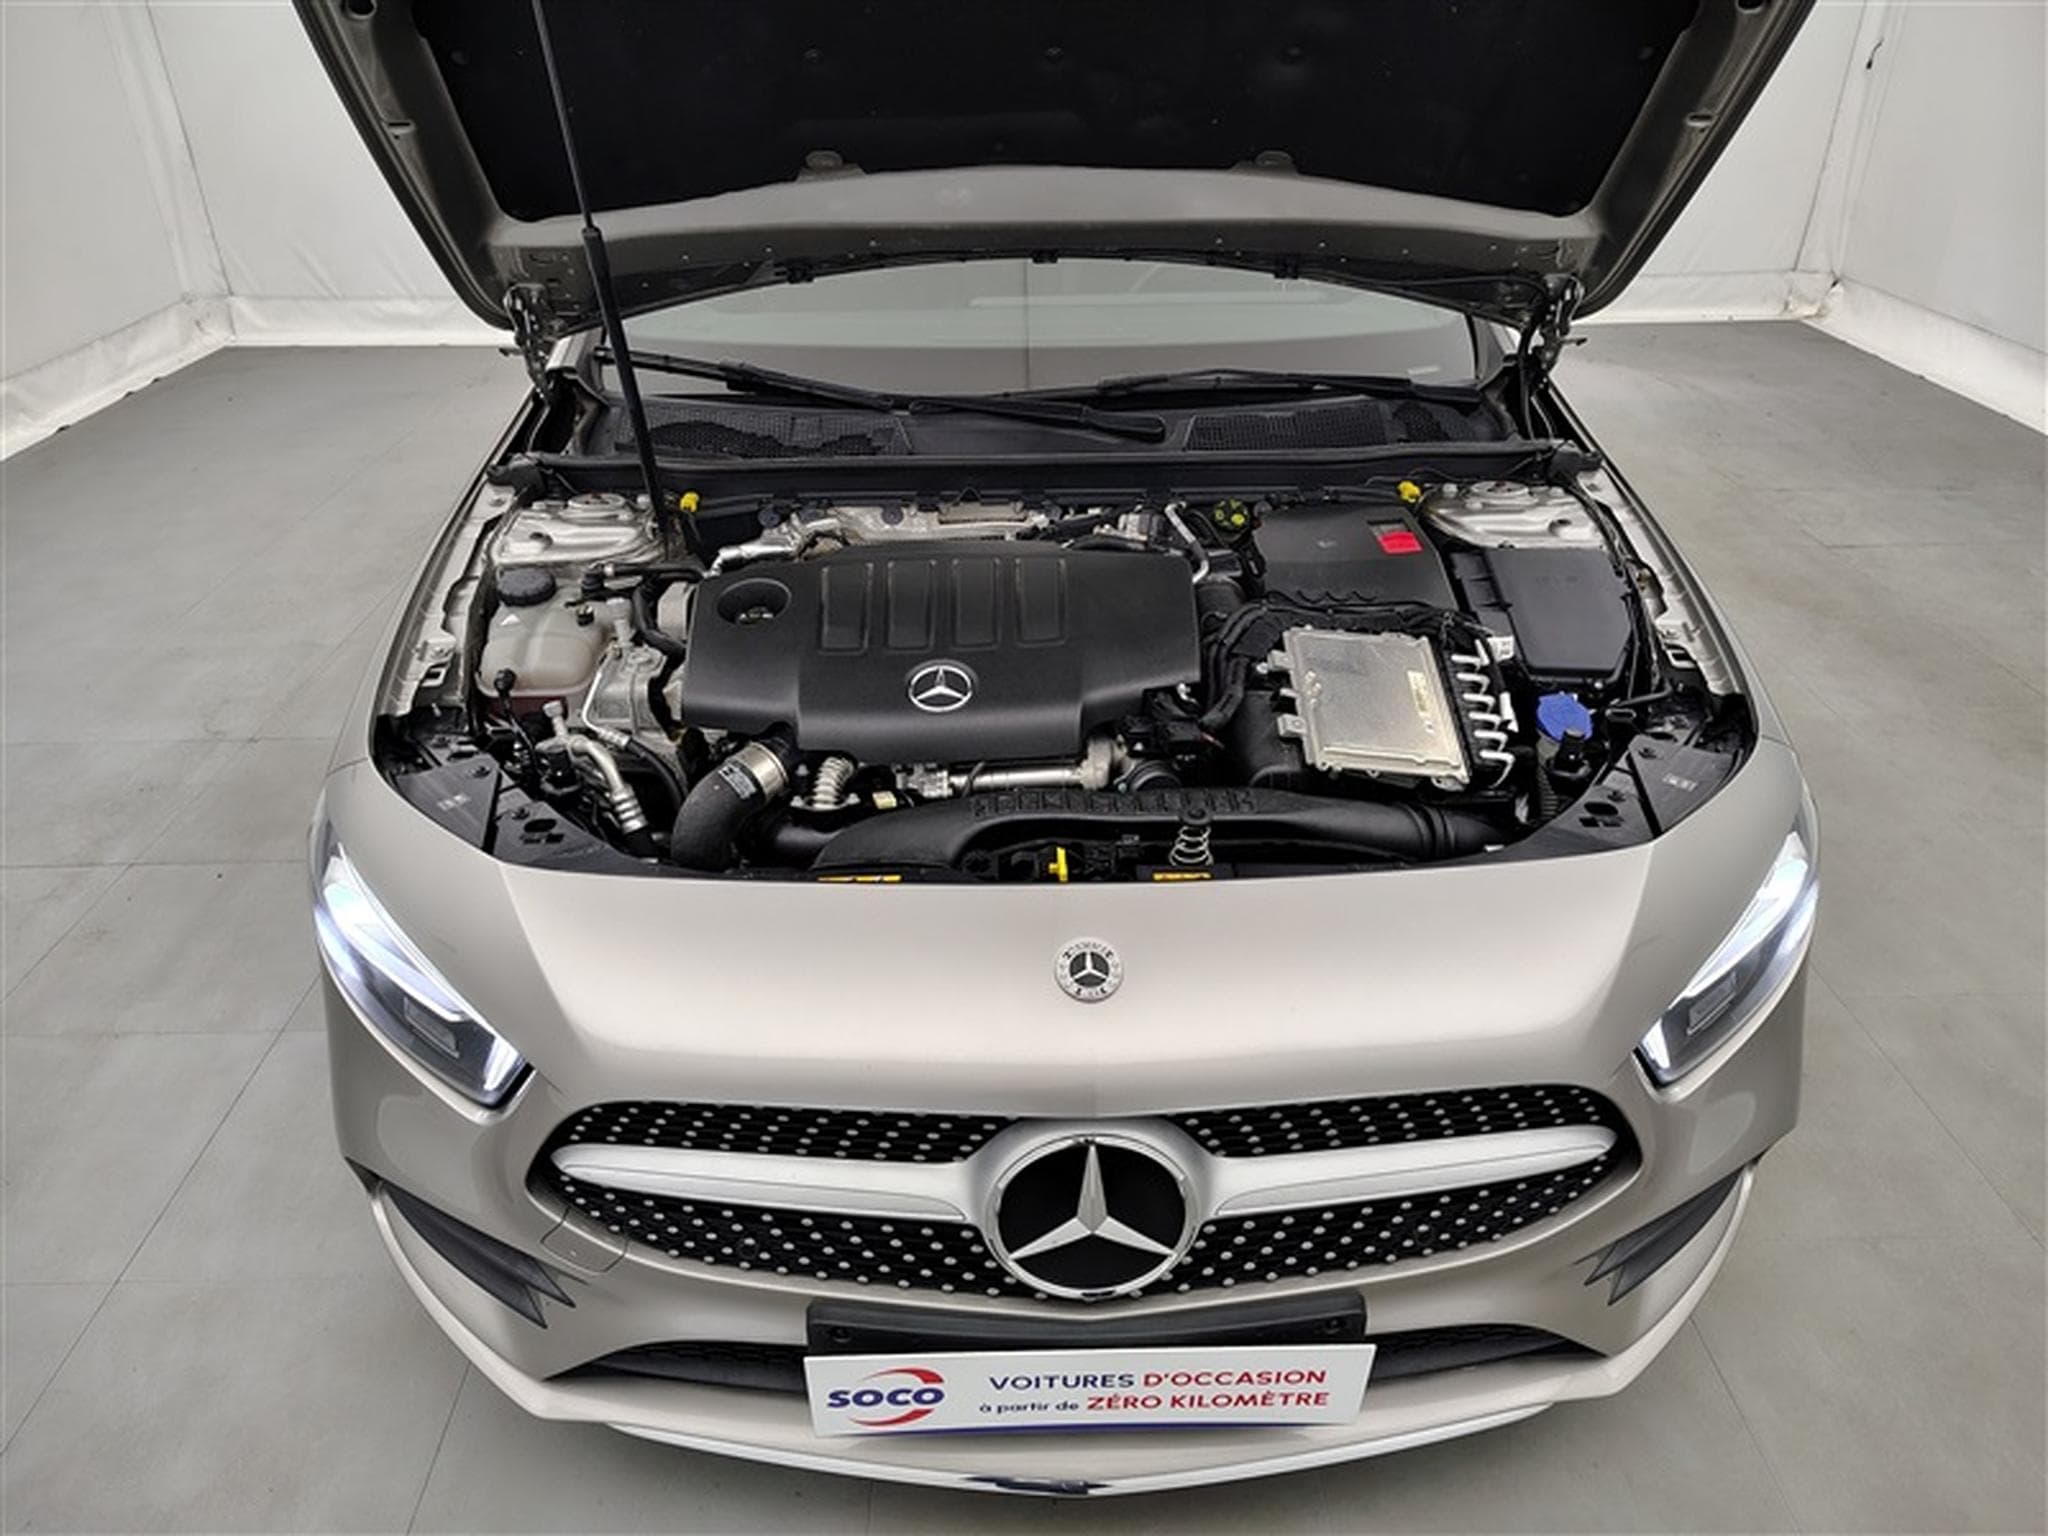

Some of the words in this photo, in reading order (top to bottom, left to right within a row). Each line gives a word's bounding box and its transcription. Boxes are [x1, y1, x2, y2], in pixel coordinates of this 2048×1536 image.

[989, 1373, 1135, 1390] VOITURES
[1143, 1370, 1327, 1388] D'OCCASION
[827, 1387, 945, 1408] SOCO
[979, 1397, 993, 1413] à
[997, 1400, 1050, 1415] partir
[1055, 1400, 1080, 1411] de
[1087, 1393, 1163, 1410] ZÉRO
[1170, 1390, 1330, 1409] KILOMÈTRE
